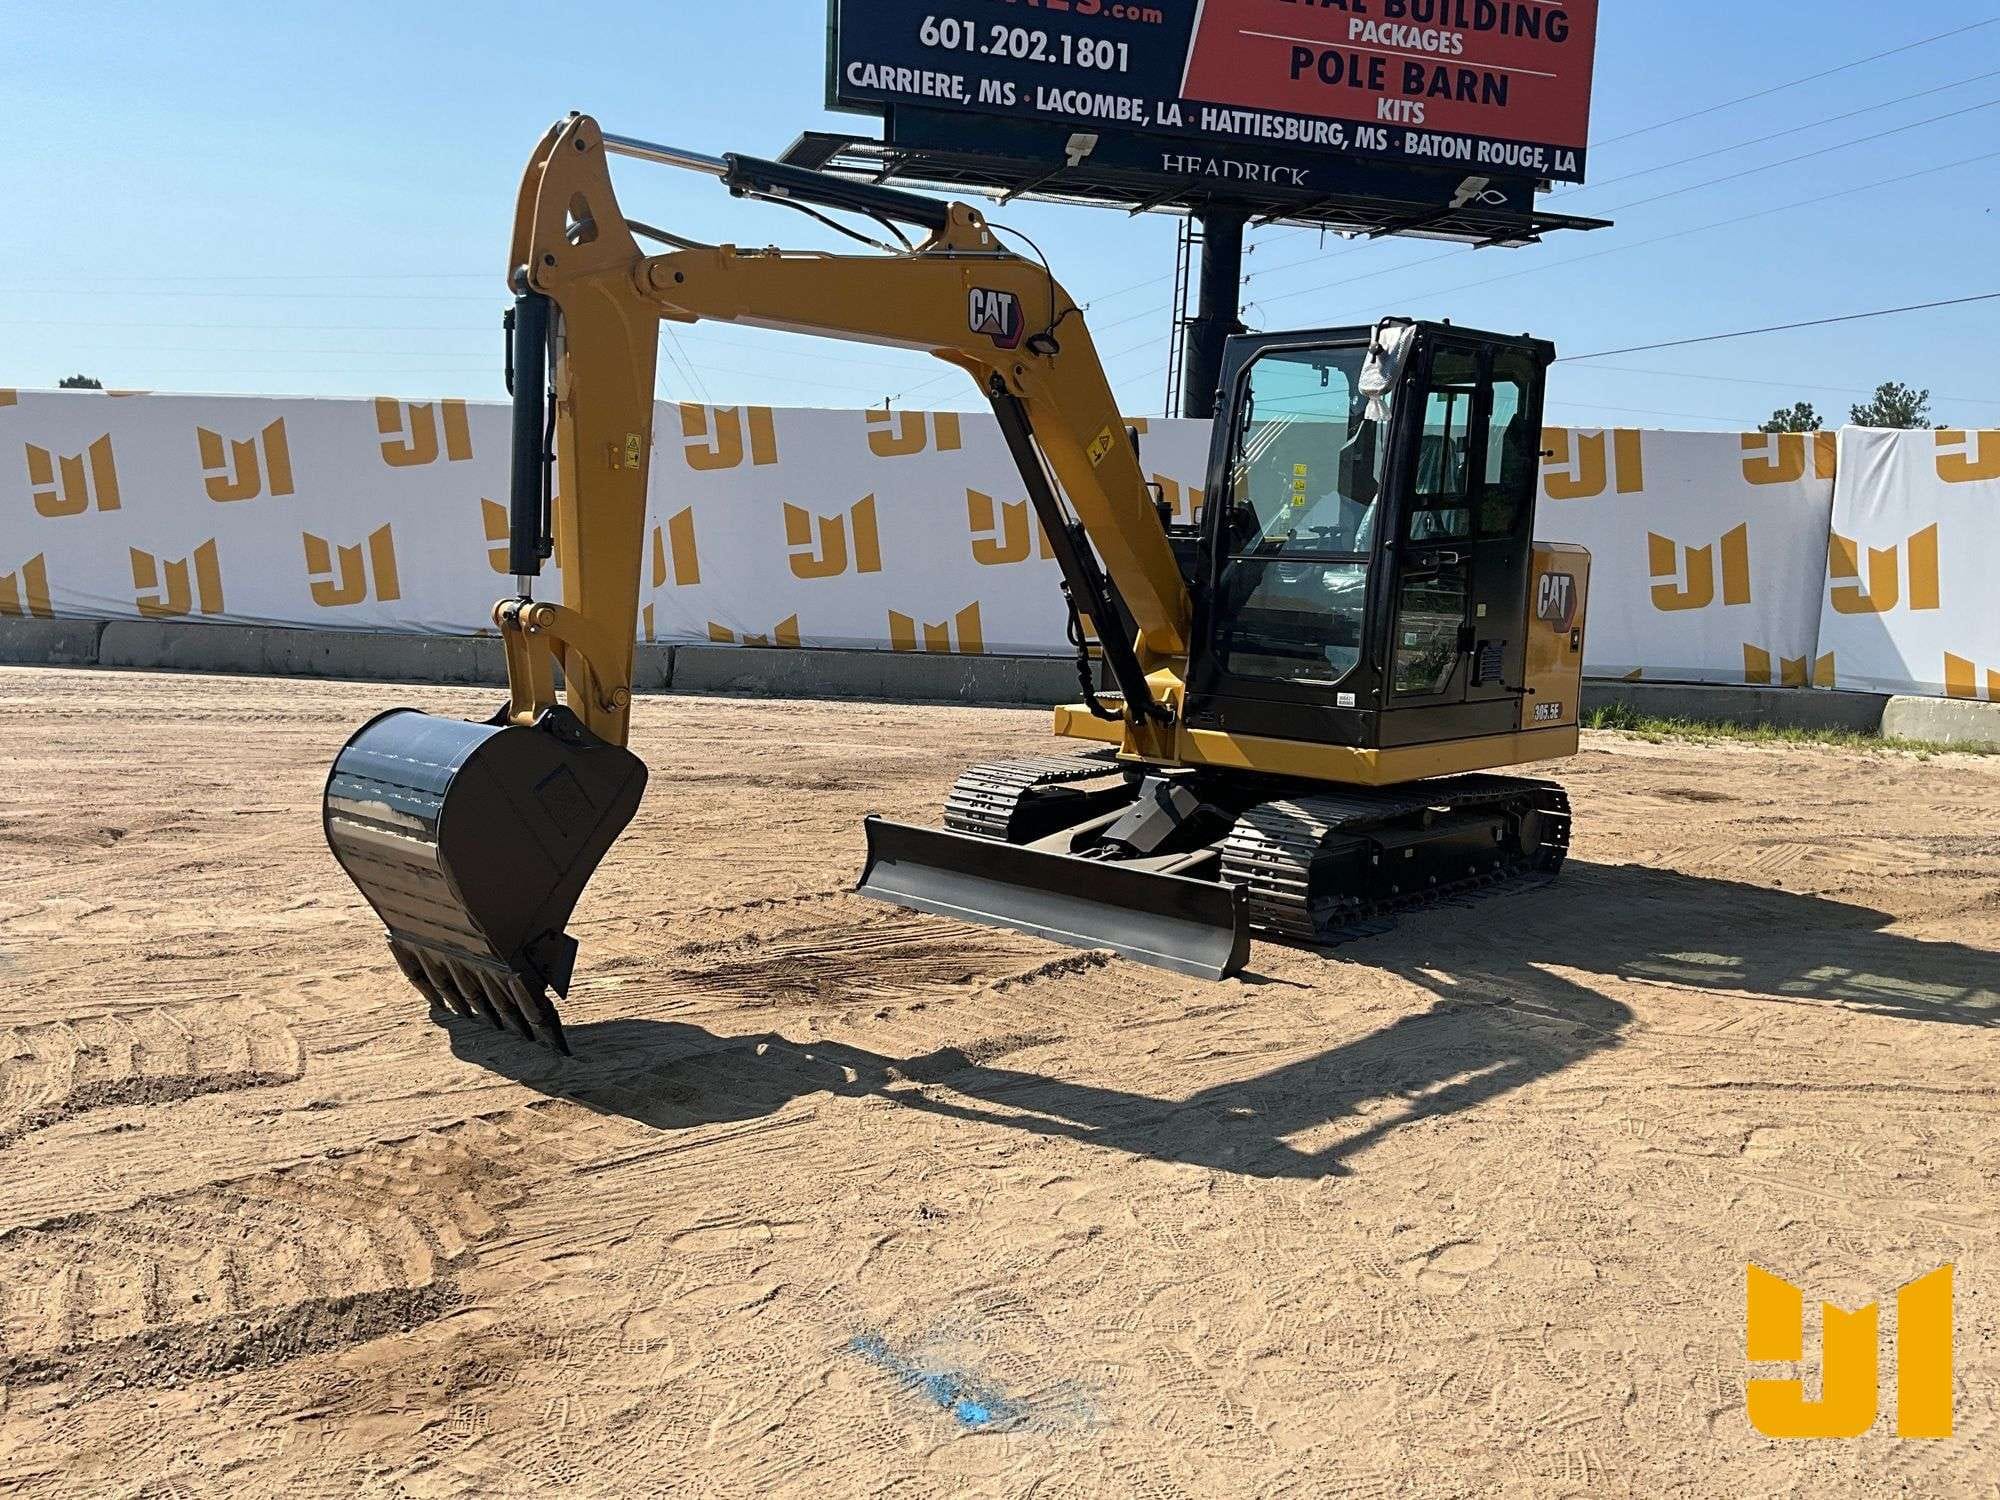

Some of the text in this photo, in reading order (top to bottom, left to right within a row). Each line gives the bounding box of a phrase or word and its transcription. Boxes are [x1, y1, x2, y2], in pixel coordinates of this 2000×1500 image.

[919, 16, 1129, 73] 601.202.1801
[1348, 18, 1464, 55] PACKAGES
[1385, 0, 1569, 43] BUILDING
[1290, 45, 1509, 107] POLE BARN
[847, 61, 1577, 173] CARRIERE, MS LACOMBE, LA HATTIESBURG, MS BATON ROUGE, LA
[1377, 97, 1425, 124] KITS
[1161, 153, 1311, 186] HEADRICK
[969, 288, 1012, 335] CAT
[1537, 574, 1570, 620] CAT
